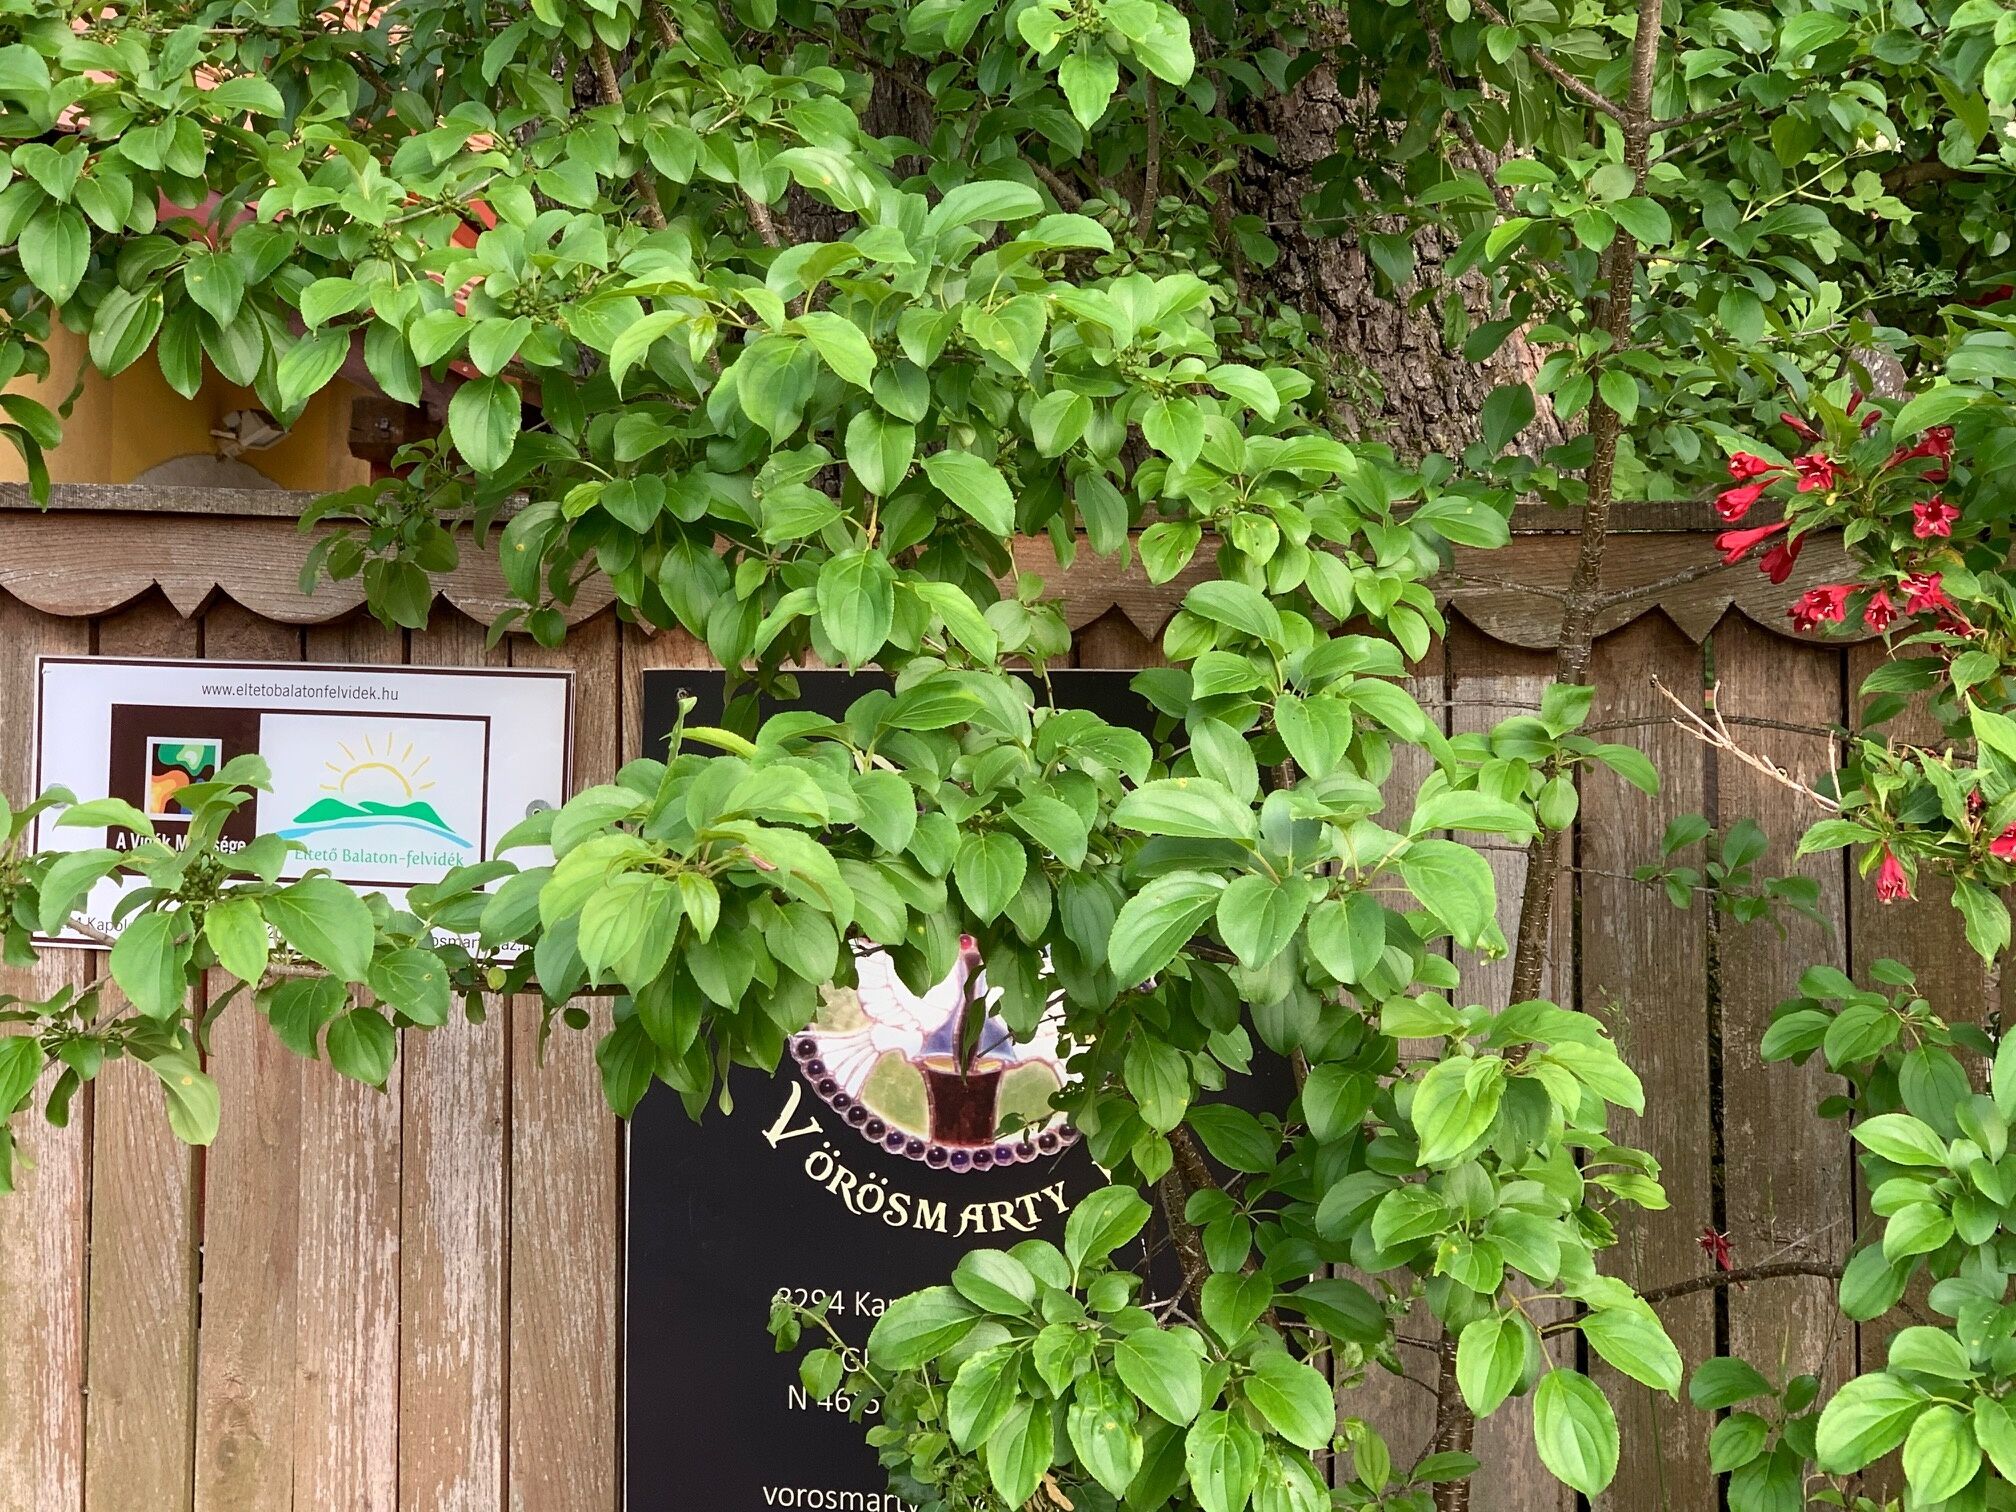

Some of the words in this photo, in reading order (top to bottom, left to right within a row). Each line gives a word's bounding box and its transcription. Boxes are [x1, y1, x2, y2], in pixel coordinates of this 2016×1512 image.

[201, 682, 399, 701] www.eltetobalatonfelvidek.hu
[115, 831, 127, 850] A
[342, 848, 464, 868] Balaton-felvidék
[761, 1080, 1070, 1238] VÖRÖSMARTY
[788, 1384, 807, 1410] N
